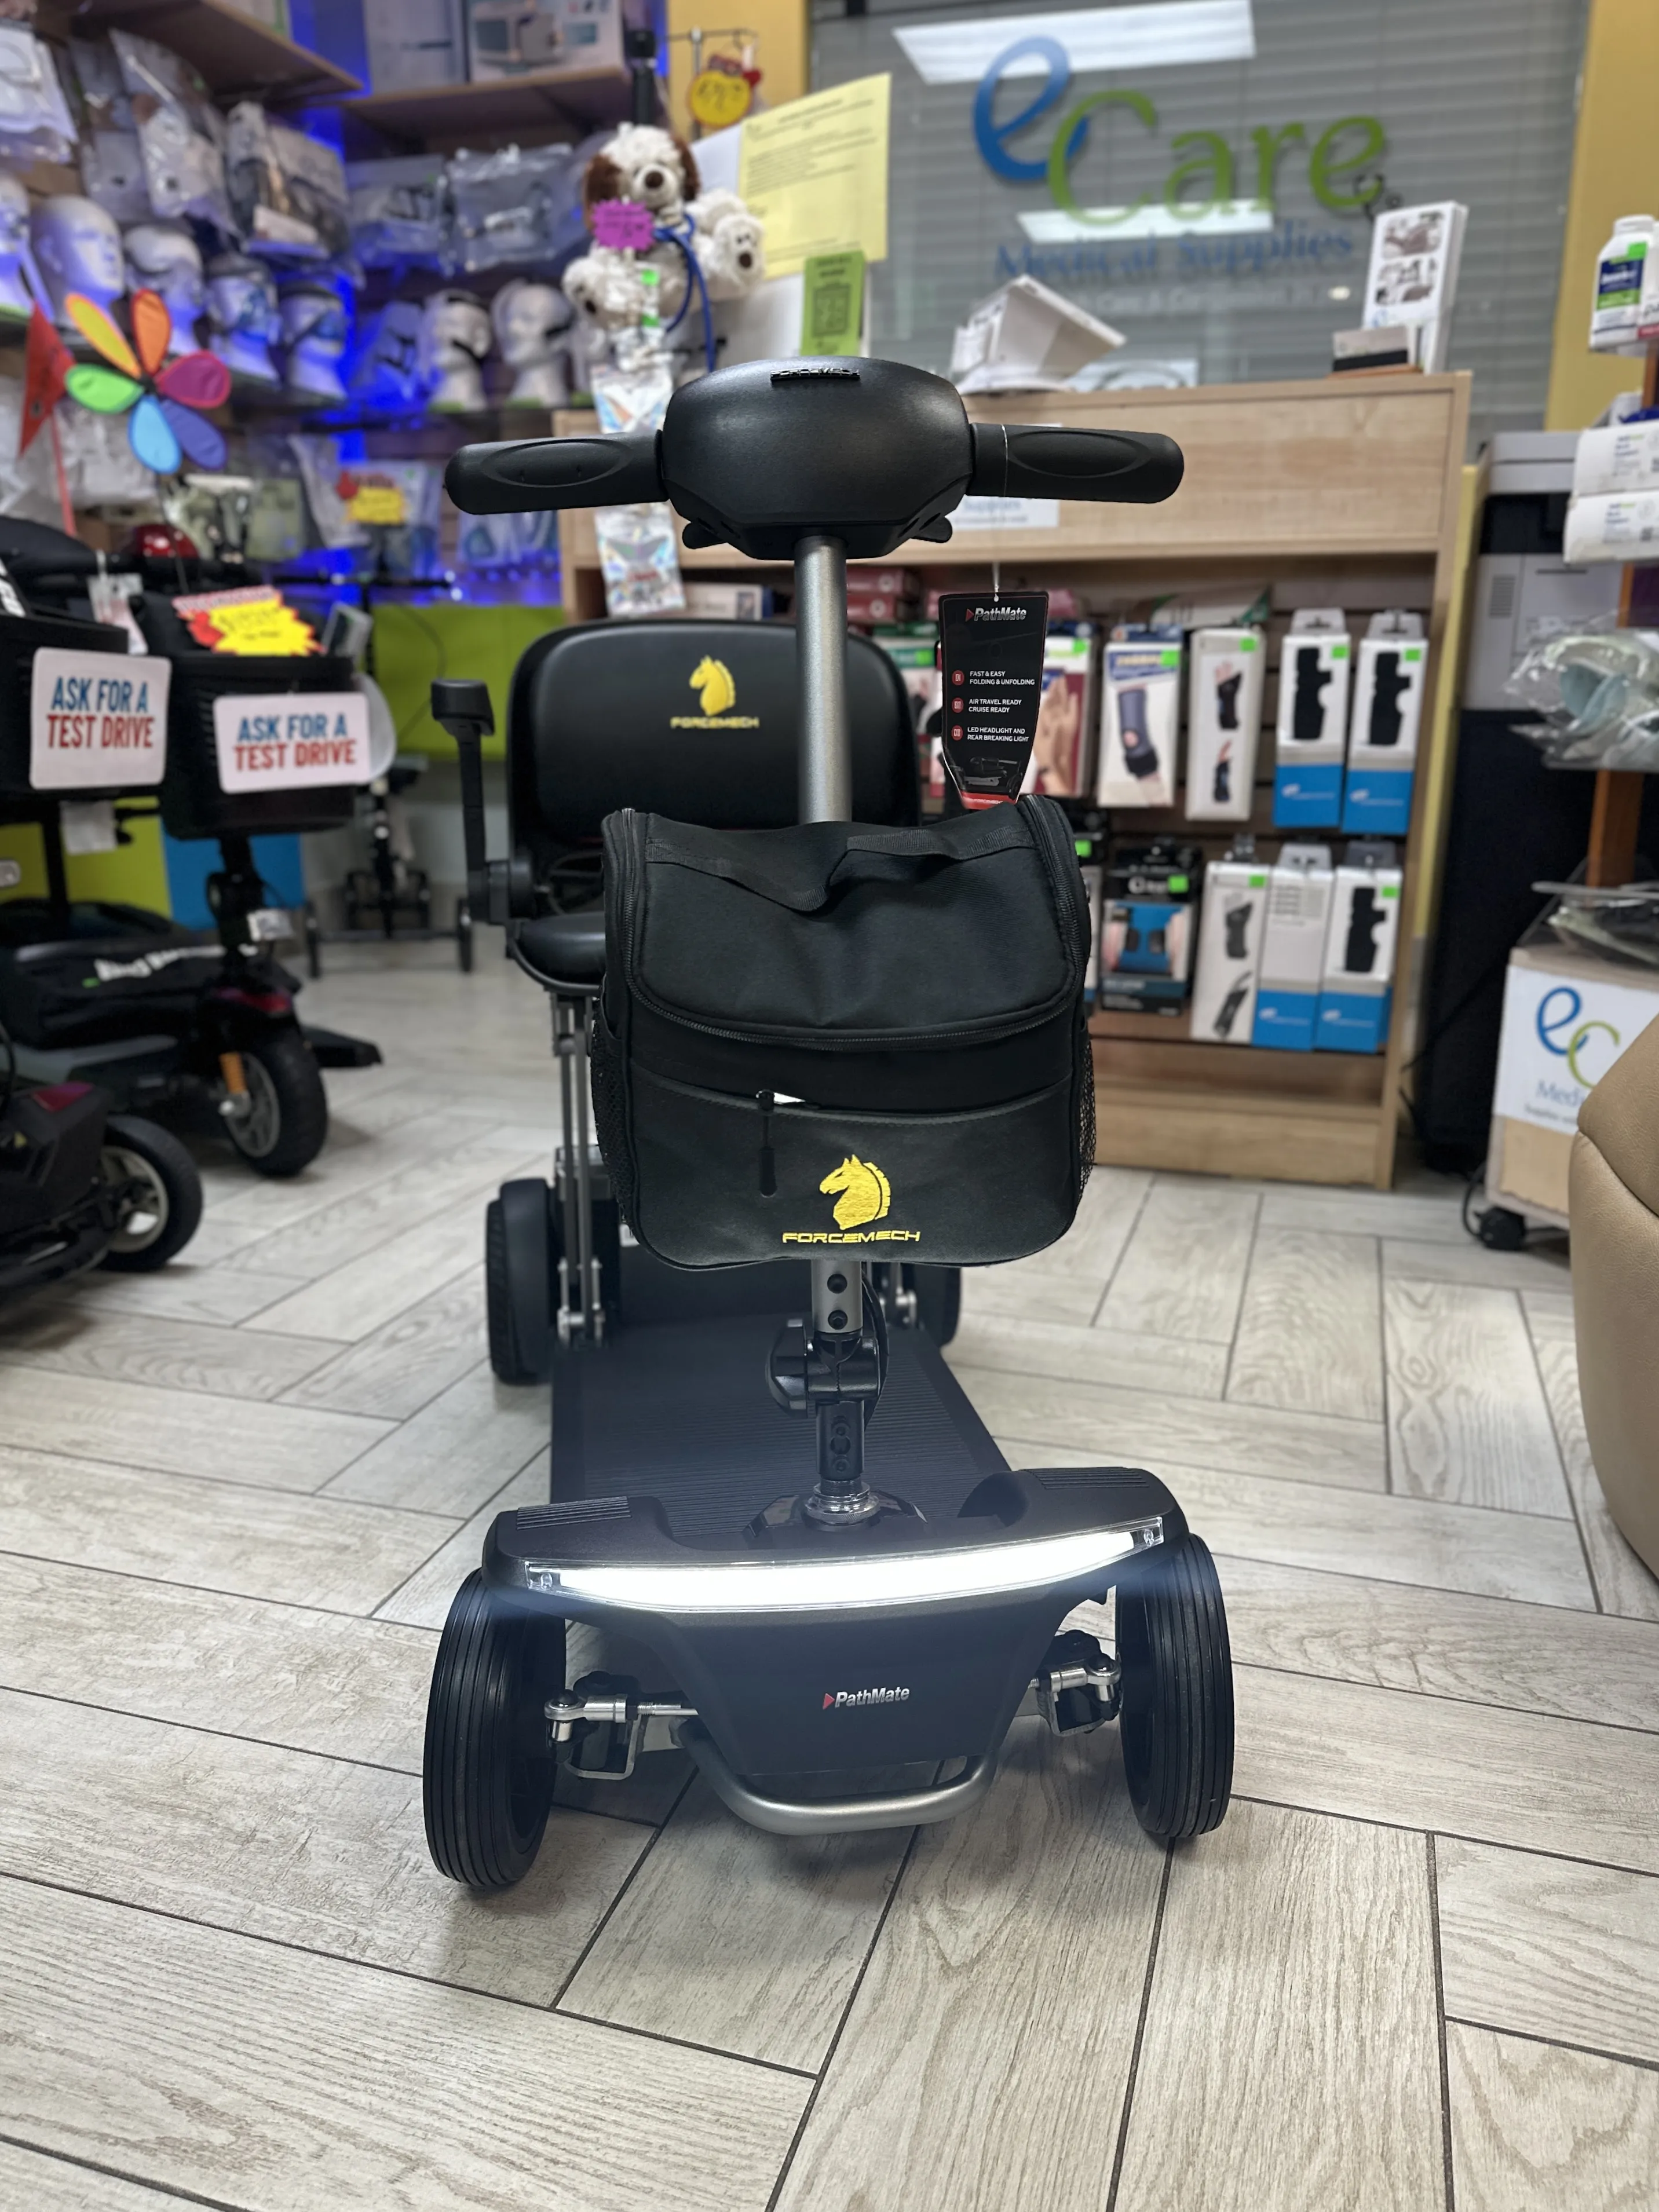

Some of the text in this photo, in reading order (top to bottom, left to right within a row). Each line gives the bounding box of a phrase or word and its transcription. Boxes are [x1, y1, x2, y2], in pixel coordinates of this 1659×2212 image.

[1178, 218, 1354, 273] Supplies
[974, 606, 1026, 621] PathMate
[51, 676, 148, 712] ASK FOR A
[46, 714, 154, 749] TEST DRIVE
[237, 711, 348, 742] ASK FOR A
[233, 739, 357, 772] TEST DRIVE
[782, 1230, 921, 1244] FORCEMECH
[834, 1687, 910, 1708] PathMate
